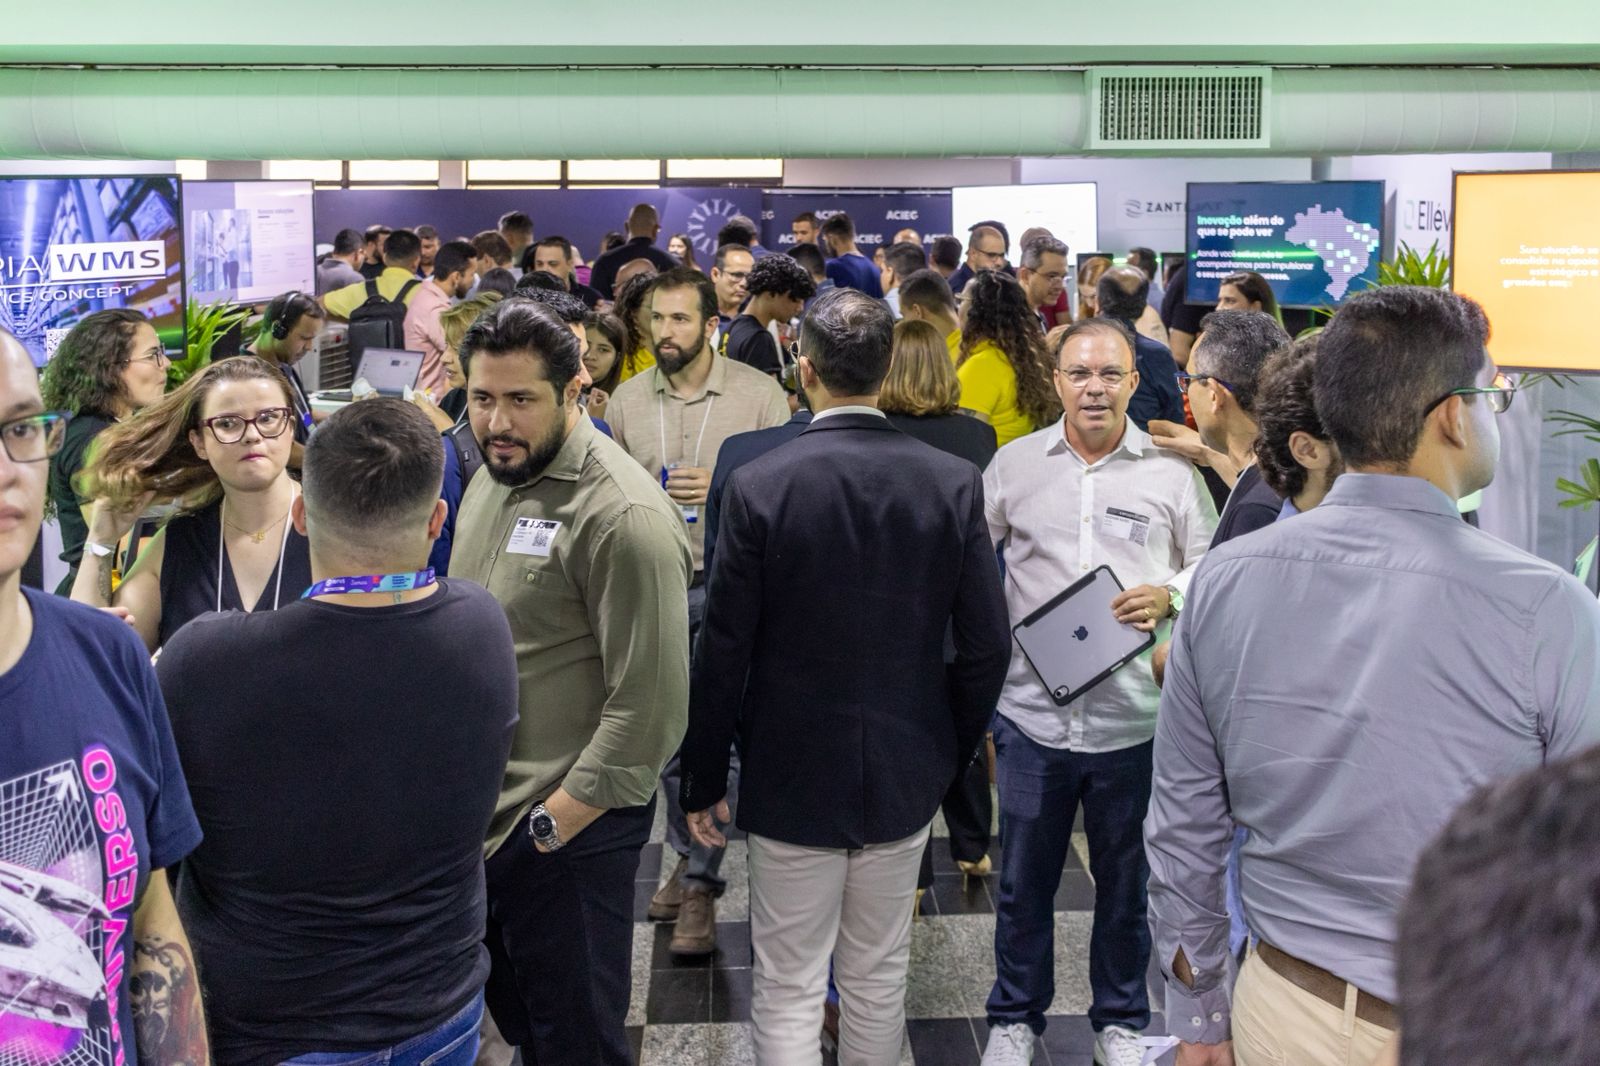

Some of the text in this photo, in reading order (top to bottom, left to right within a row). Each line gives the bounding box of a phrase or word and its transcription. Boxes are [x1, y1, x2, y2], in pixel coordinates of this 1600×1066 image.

[1146, 202, 1188, 213] ZANT
[885, 209, 919, 220] ACIEG
[1197, 215, 1242, 228] Inovação
[1243, 214, 1270, 226] além
[1270, 214, 1285, 226] do
[1197, 227, 1274, 239] que se pode ver
[56, 249, 161, 273] WMS
[1196, 261, 1314, 271] acompanhamos para impulsionar
[41, 285, 134, 302] CONCEPT
